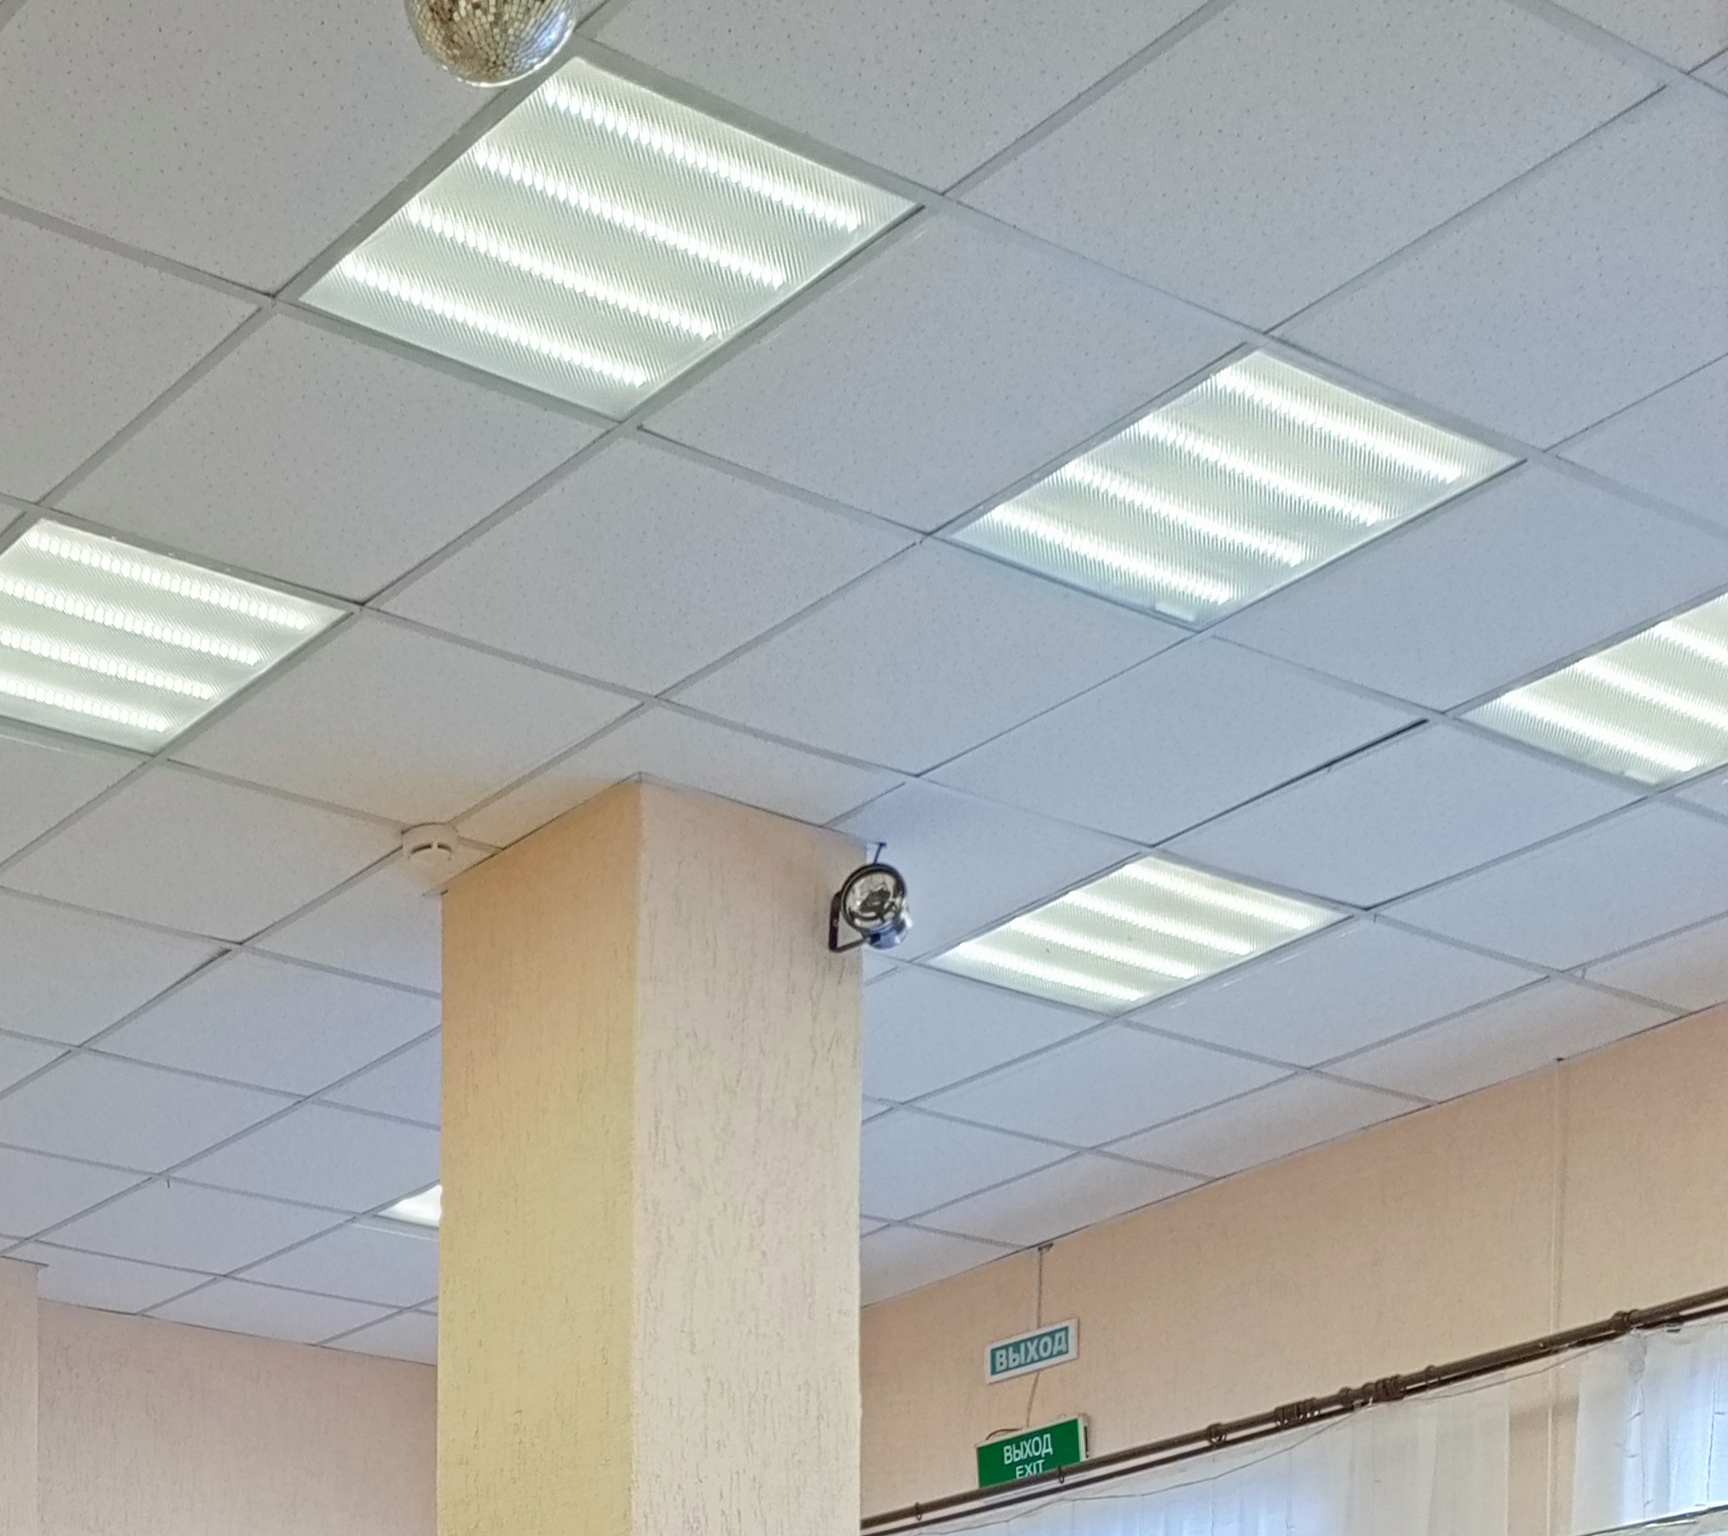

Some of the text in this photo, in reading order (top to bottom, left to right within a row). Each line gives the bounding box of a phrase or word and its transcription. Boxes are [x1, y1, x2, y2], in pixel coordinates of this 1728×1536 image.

[995, 1331, 1068, 1373] ВЫХОД
[1003, 1434, 1054, 1465] ВЫХОД
[1015, 1459, 1046, 1479] EXIT
